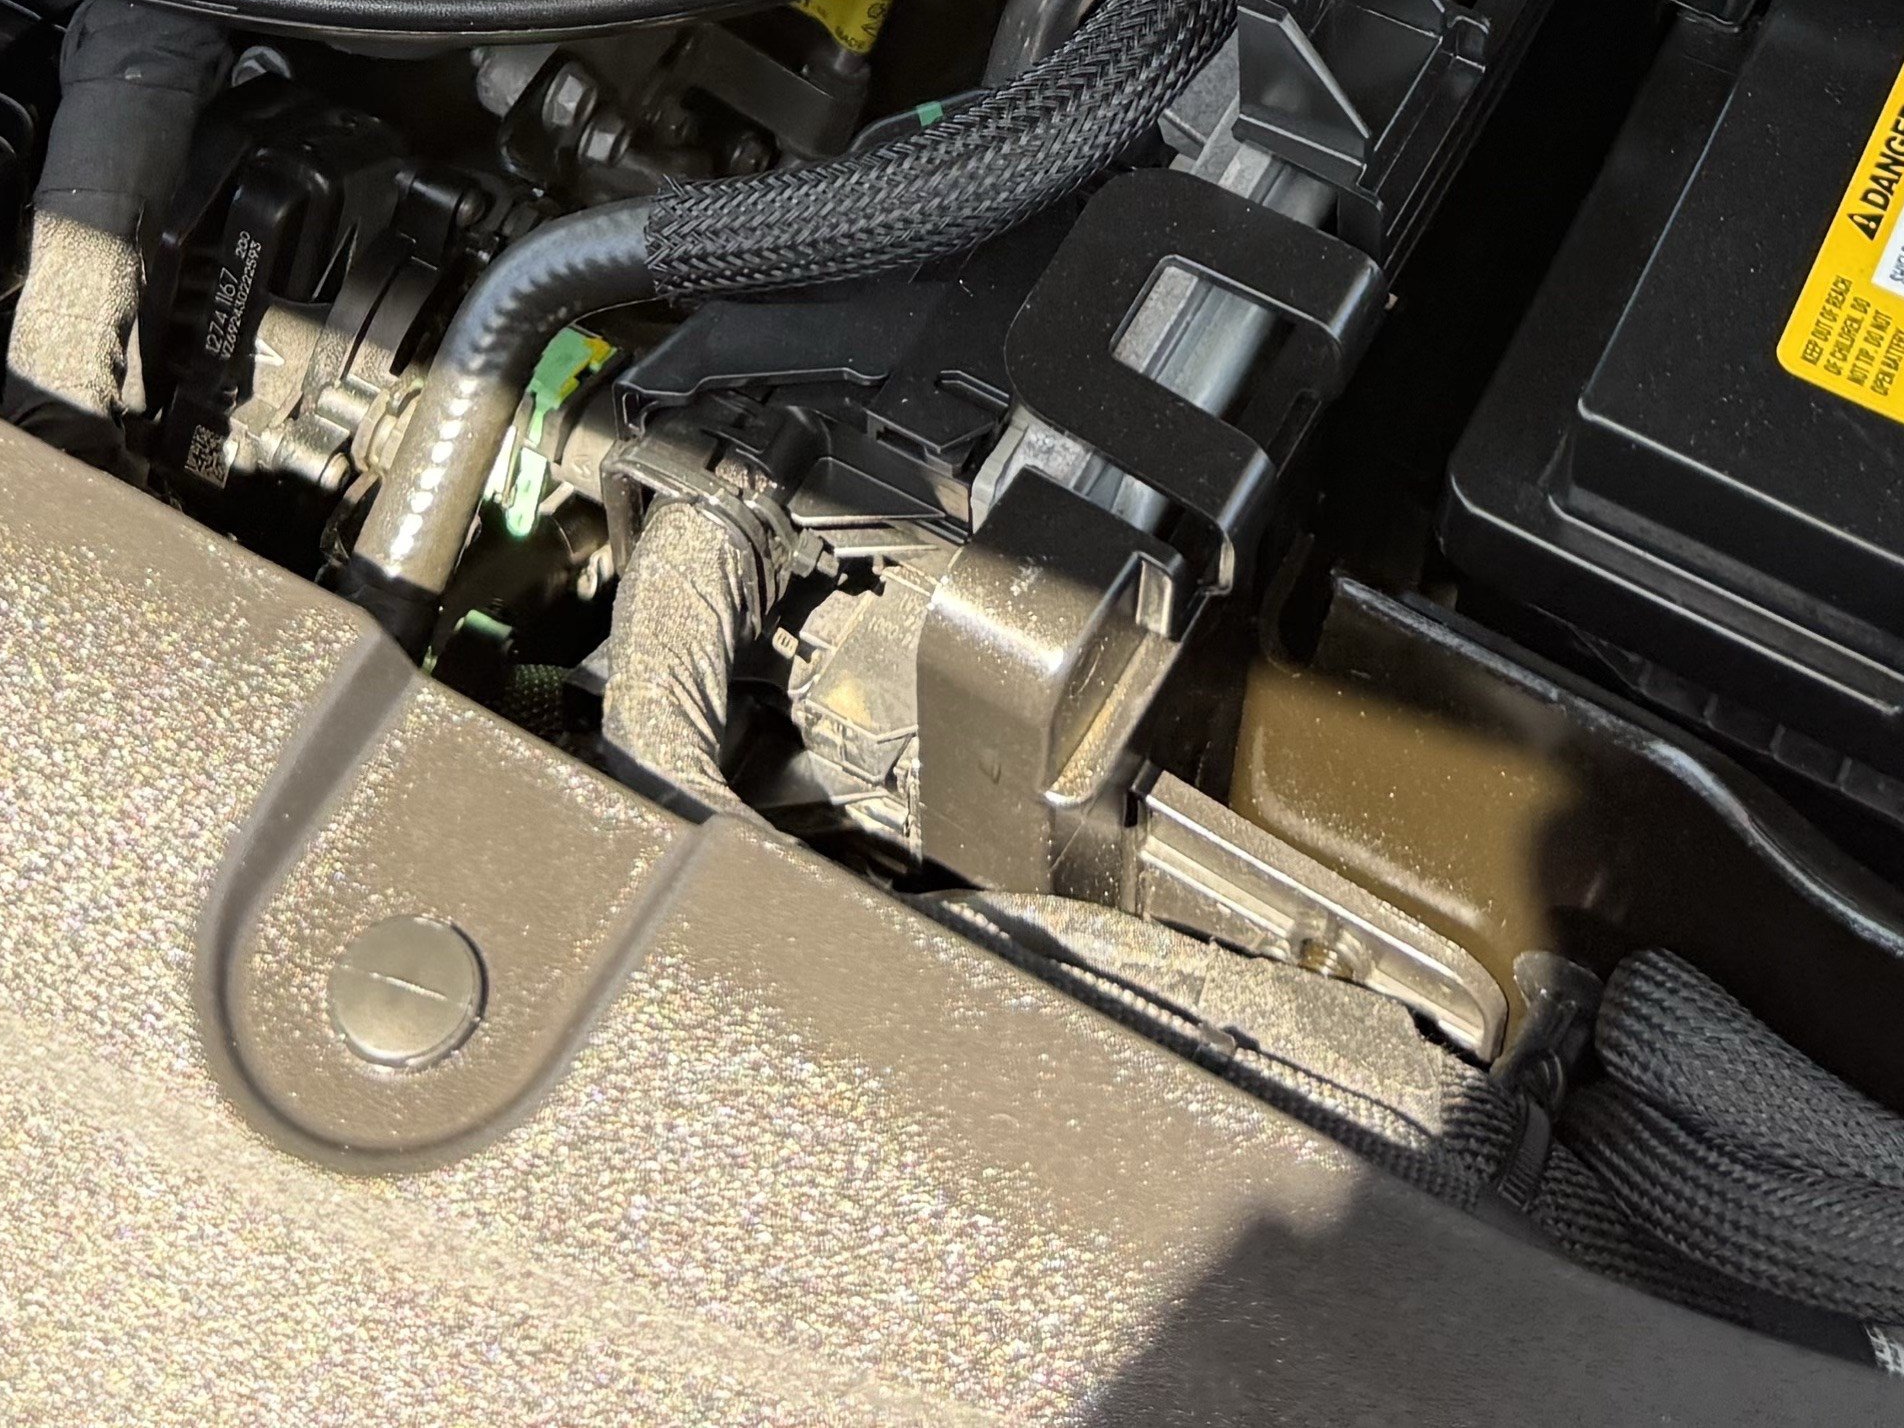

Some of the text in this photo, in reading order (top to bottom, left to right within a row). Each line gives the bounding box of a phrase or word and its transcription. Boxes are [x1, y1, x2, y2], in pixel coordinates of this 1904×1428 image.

[205, 231, 251, 354] 1274 1167 200
[1810, 318, 1833, 342] OUT
[1800, 338, 1823, 365] KEEP
[1846, 362, 1869, 386] NOT
[1870, 368, 1895, 396] OPEN
